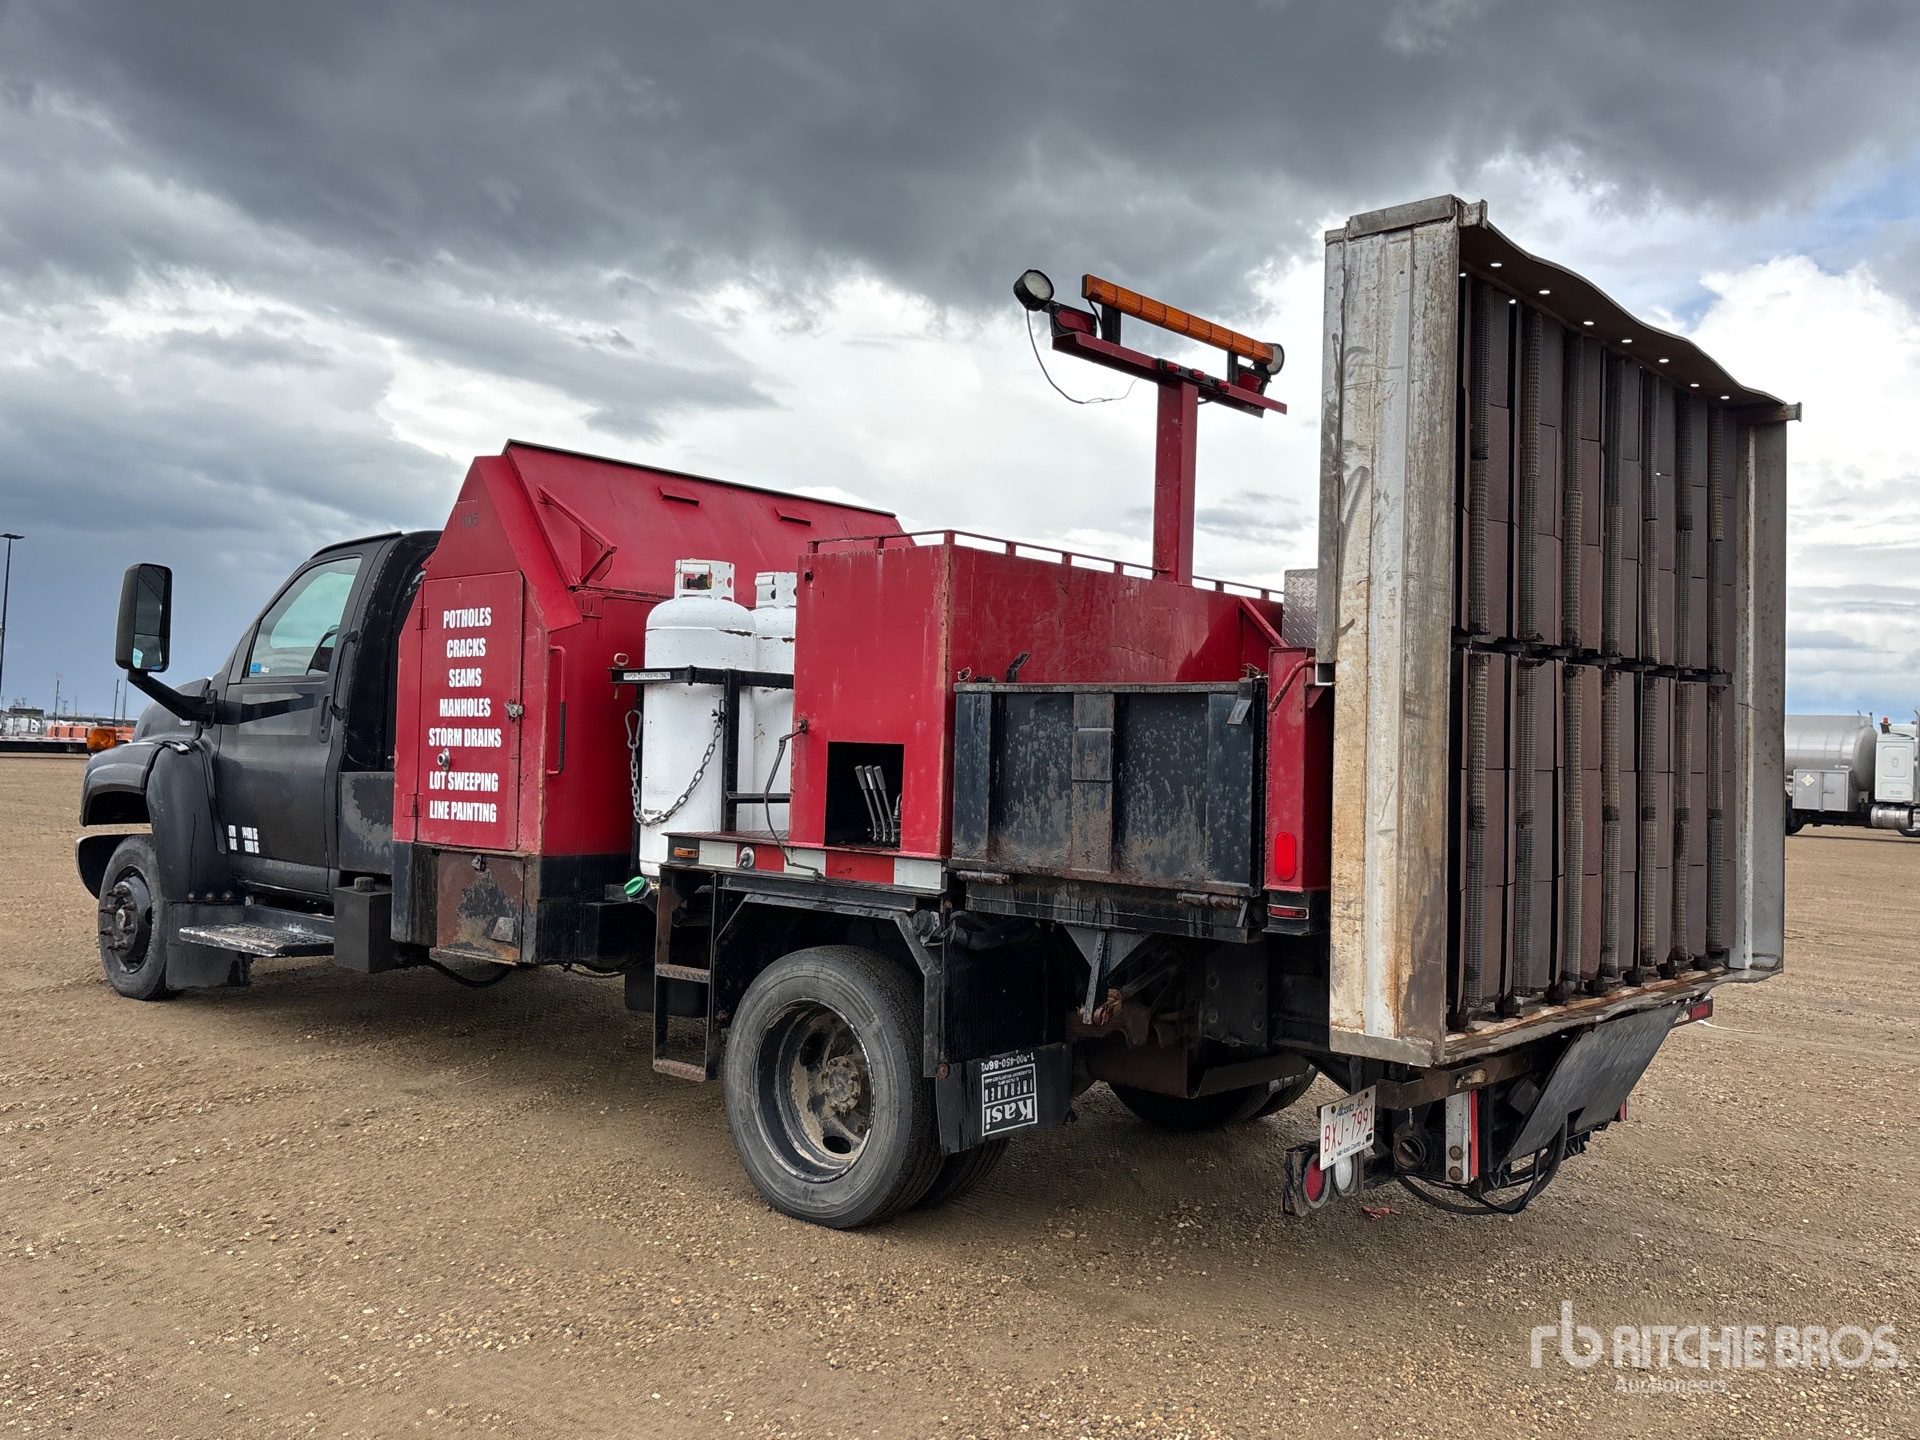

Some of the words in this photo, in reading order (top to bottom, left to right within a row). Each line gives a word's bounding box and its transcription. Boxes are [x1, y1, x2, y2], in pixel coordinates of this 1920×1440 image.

[443, 607, 492, 630] POTHOLES
[446, 637, 487, 658] CRACKS
[449, 668, 482, 688] SEAMS
[439, 698, 491, 717] MANHOLES
[428, 727, 463, 747] STORM
[464, 728, 502, 748] DRAINS
[429, 771, 446, 790] LOT
[447, 772, 499, 792] SWEEPING
[429, 800, 450, 820] LINE
[450, 801, 497, 823] PAINTING
[985, 1099, 1033, 1130] Kasi
[1324, 1104, 1374, 1153] BXJ-7991
